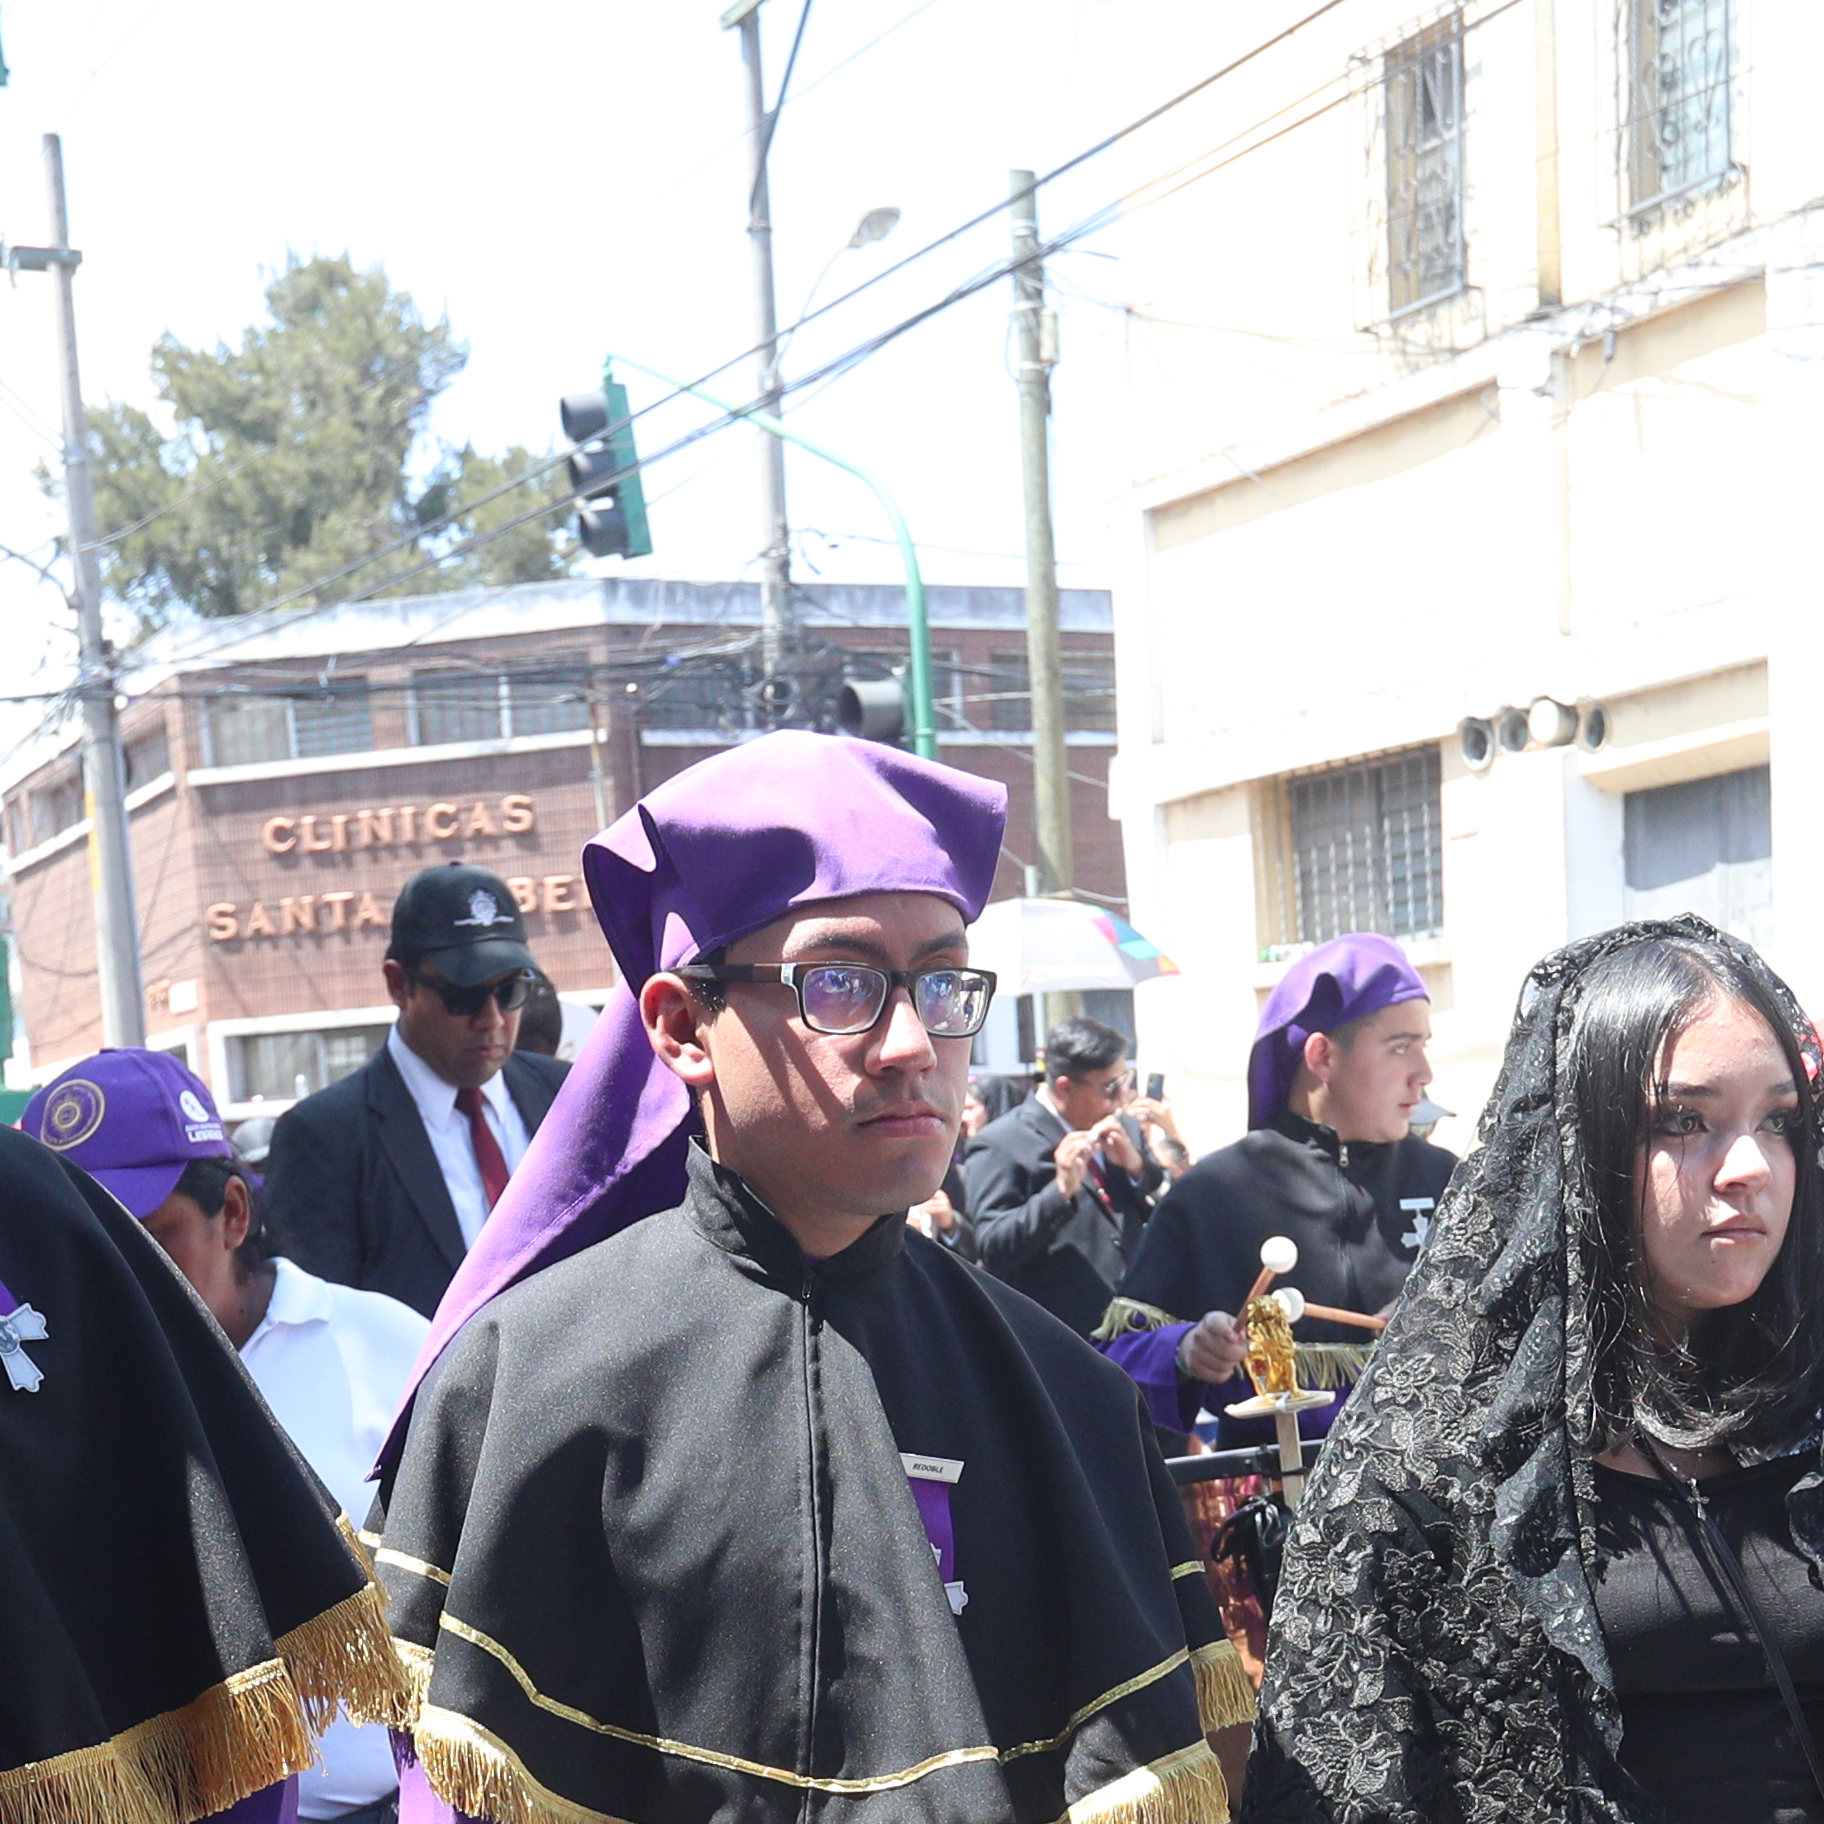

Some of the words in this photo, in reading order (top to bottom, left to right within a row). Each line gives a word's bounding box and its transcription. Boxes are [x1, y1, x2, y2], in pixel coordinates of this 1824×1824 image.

[263, 794, 534, 853] CLINICAS
[207, 891, 388, 941] SANTA
[912, 1462, 945, 1474] REDOBLE
